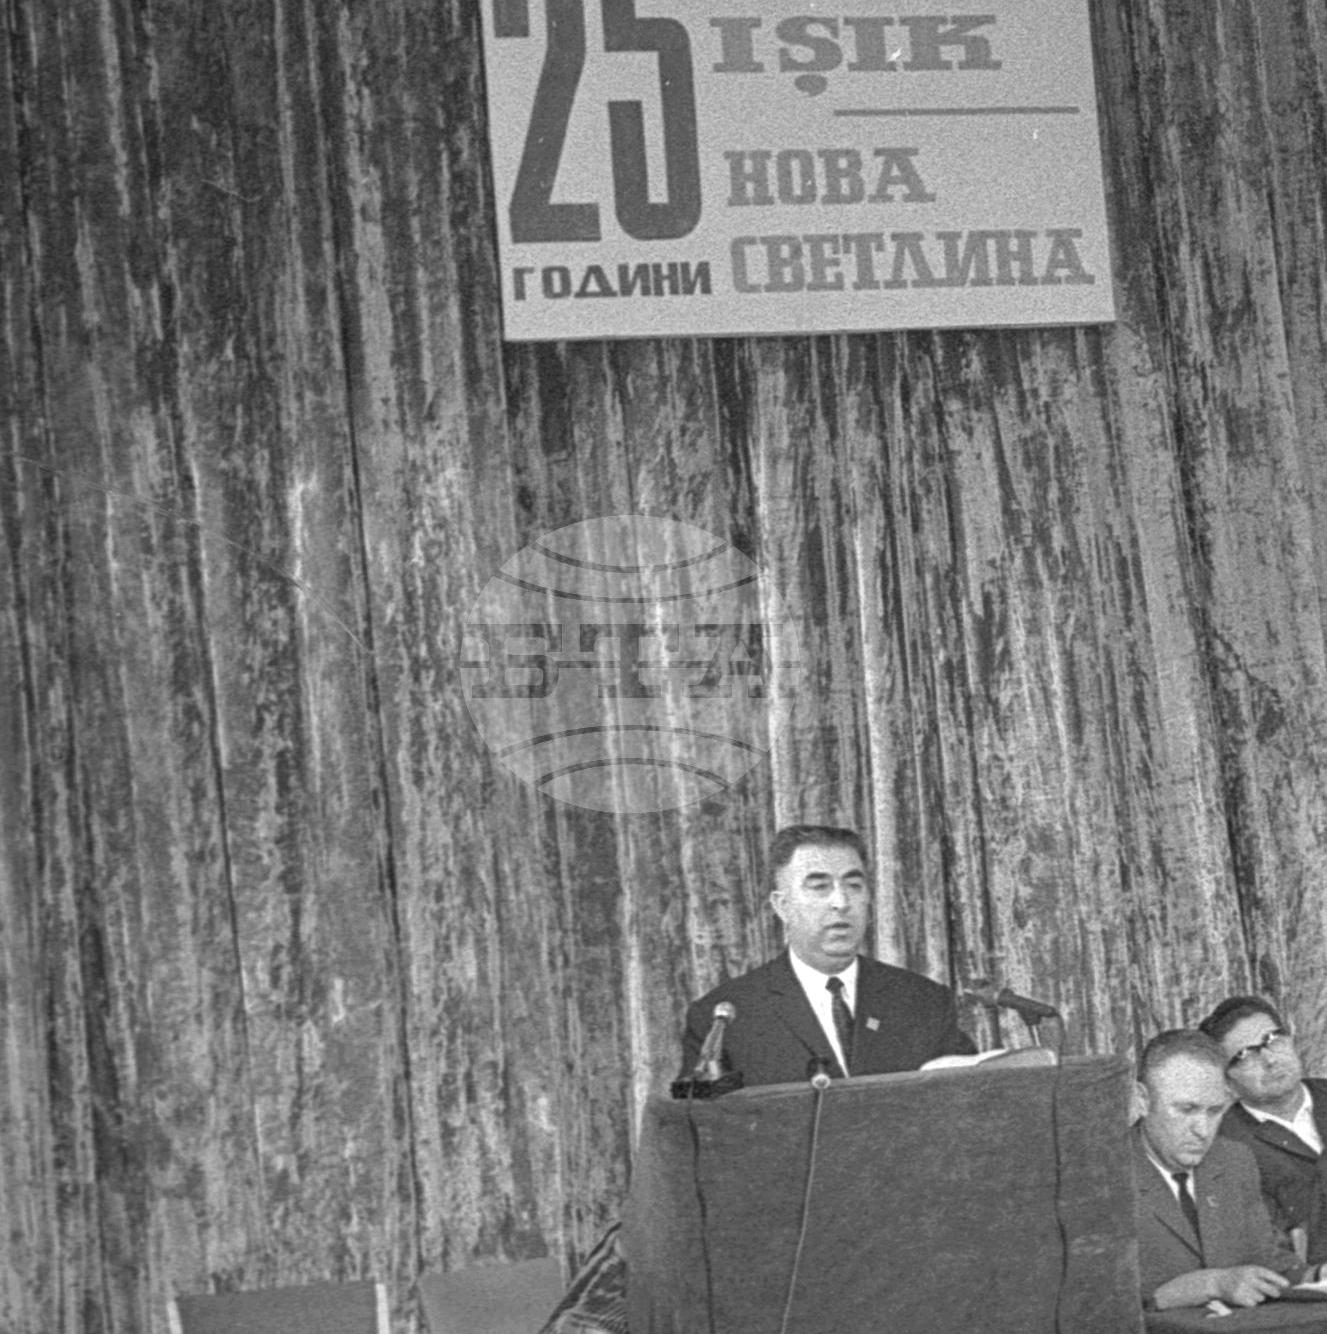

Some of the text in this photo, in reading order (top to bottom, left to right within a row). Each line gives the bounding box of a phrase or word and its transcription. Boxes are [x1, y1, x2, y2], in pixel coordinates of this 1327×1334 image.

[709, 13, 1003, 97] IŞIK
[723, 146, 936, 208] НОВА
[512, 260, 713, 302] ГОДИНИ
[730, 227, 1096, 294] СВЕТЛИНА
